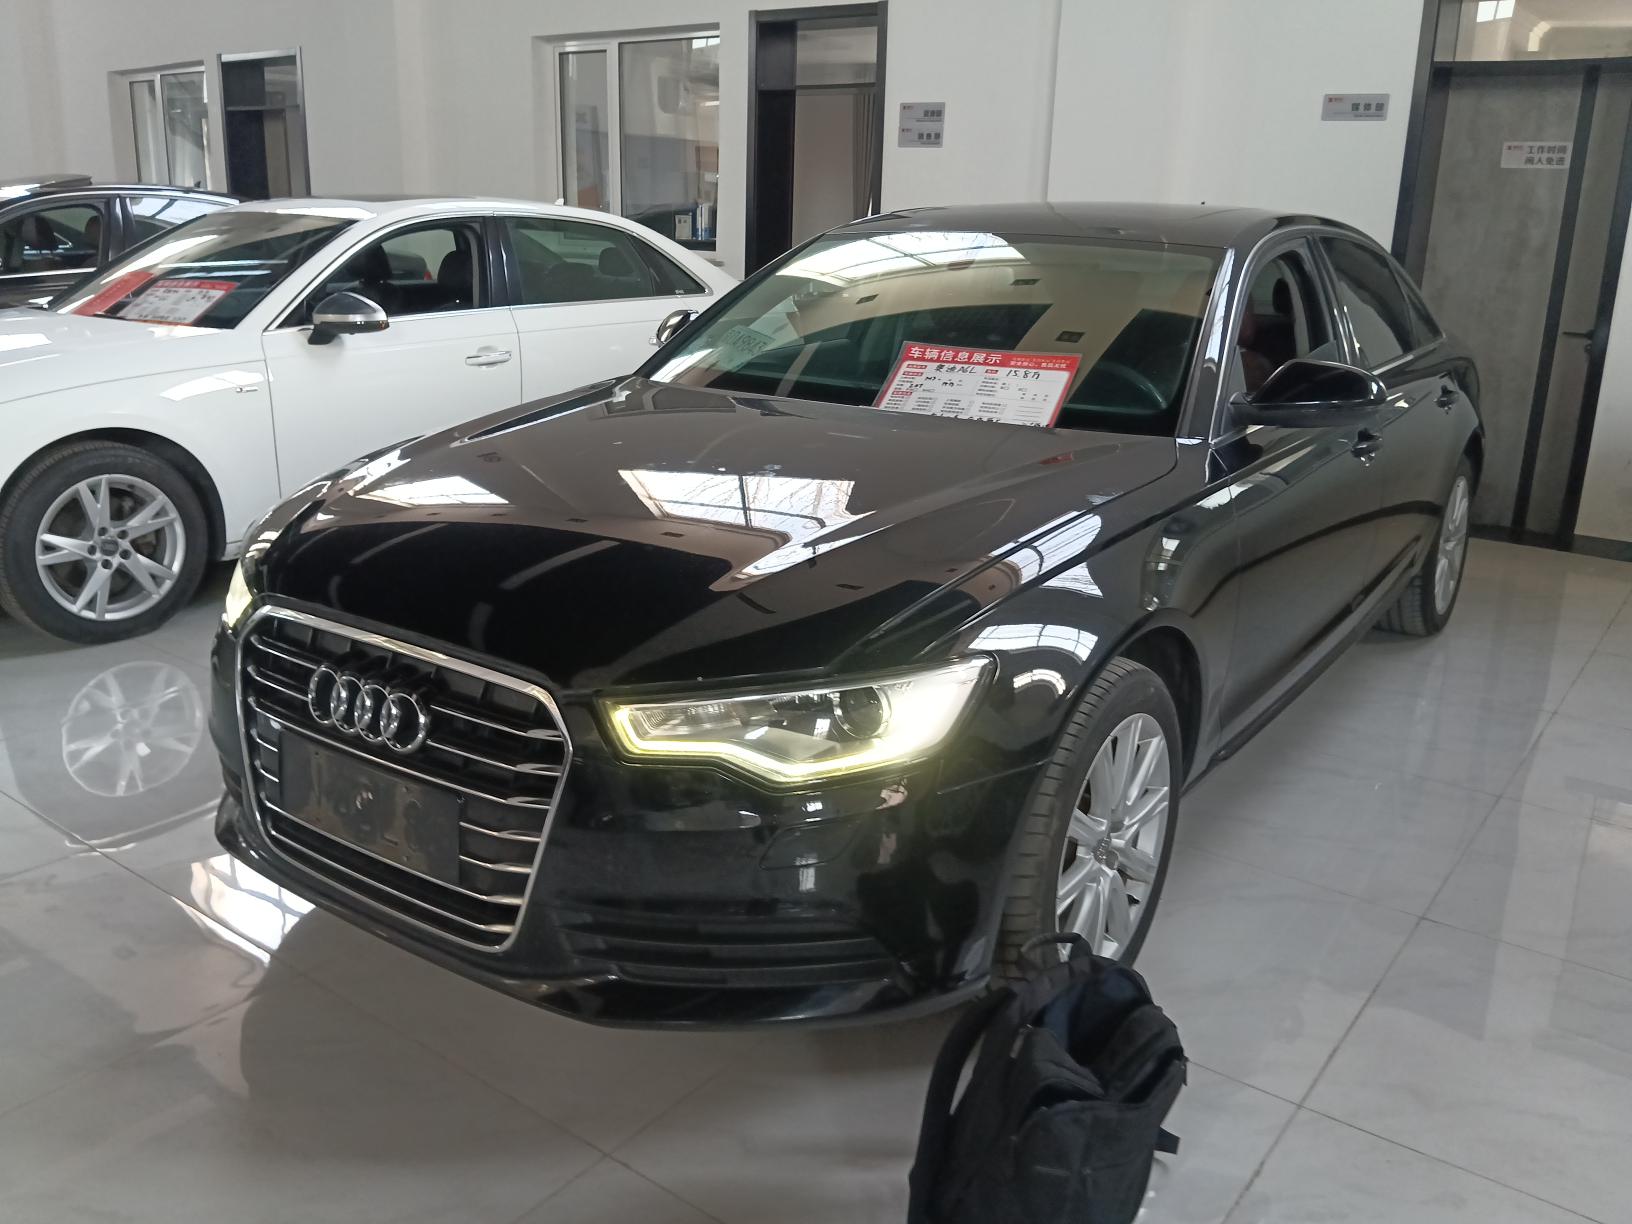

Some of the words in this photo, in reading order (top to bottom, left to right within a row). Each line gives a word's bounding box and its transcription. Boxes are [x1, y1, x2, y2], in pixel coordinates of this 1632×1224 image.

[1527, 145, 1568, 155] 工作时间
[909, 346, 1002, 364] 车辆信息展示
